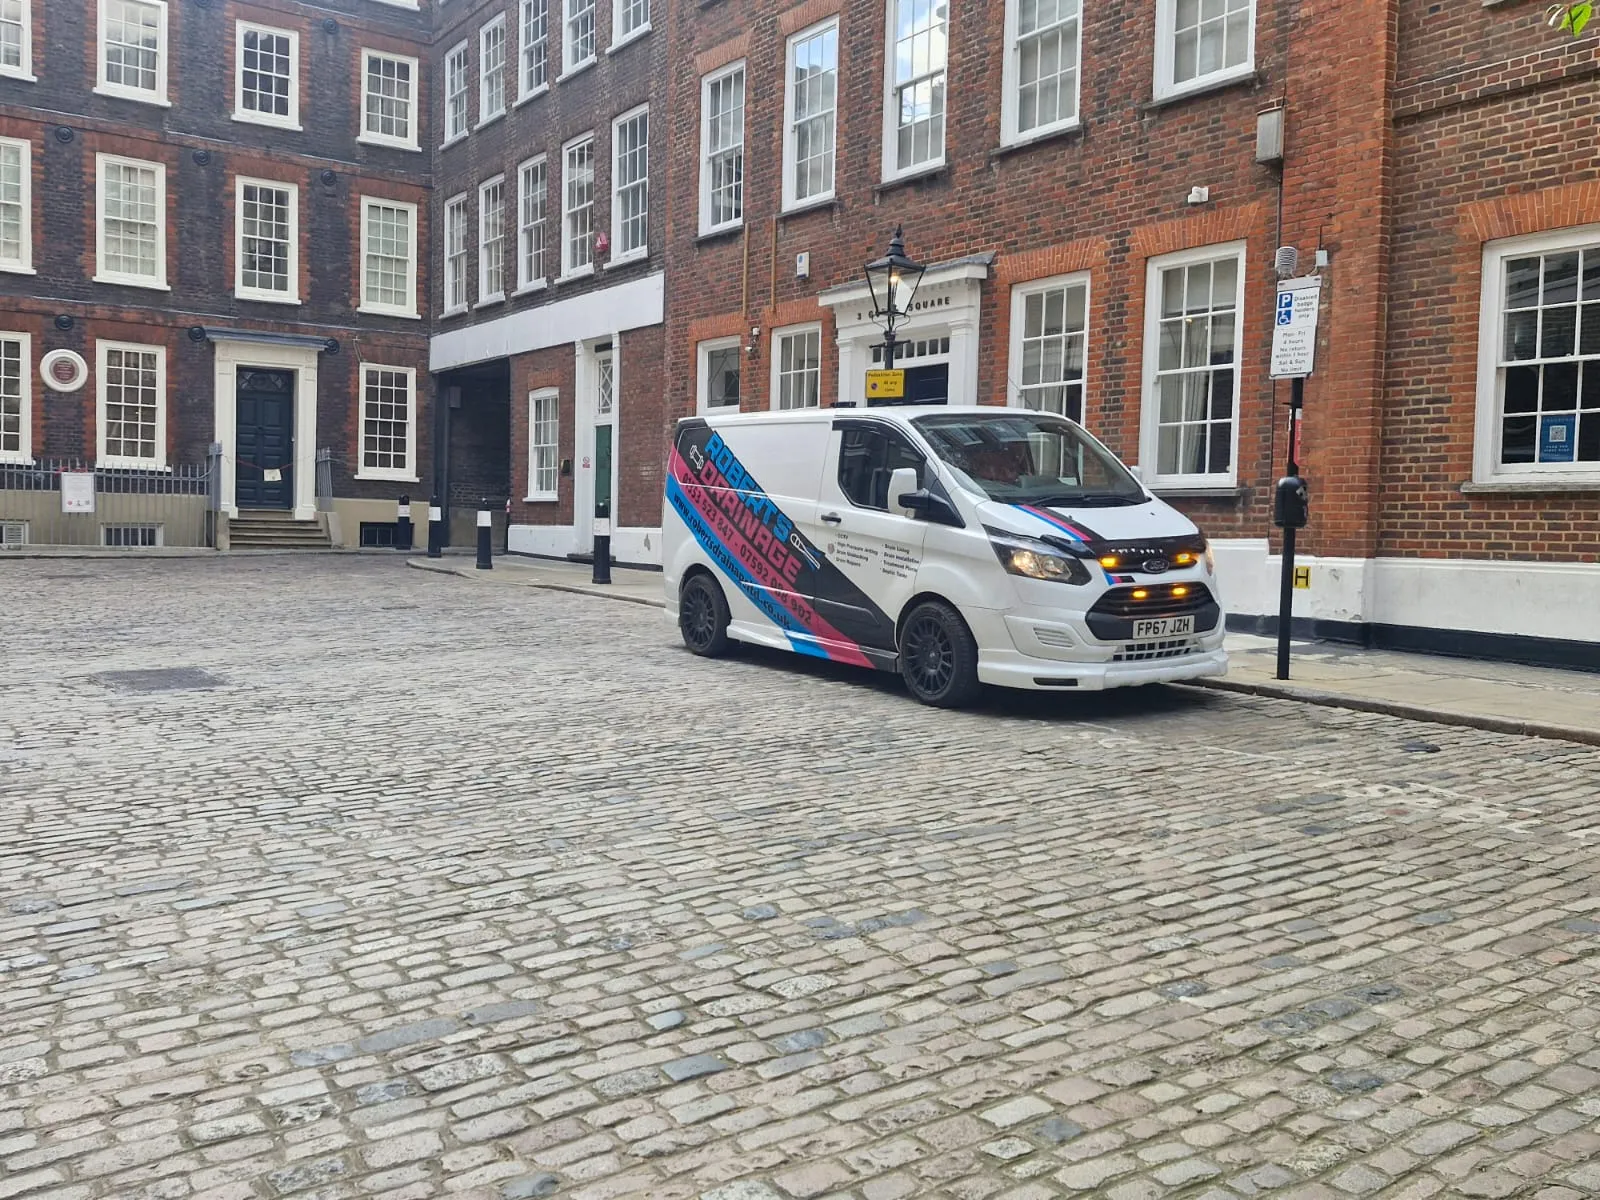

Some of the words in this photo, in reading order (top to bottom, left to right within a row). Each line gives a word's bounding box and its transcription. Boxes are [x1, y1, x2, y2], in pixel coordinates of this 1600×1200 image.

[908, 296, 951, 312] SQUARE
[704, 431, 793, 543] ROBERTS
[700, 459, 802, 583] DRAINAGE
[702, 498, 717, 523] 523
[740, 543, 769, 582] 07592
[1295, 567, 1309, 586] H
[1137, 620, 1167, 637] FP67
[1170, 617, 1190, 633] JZH
